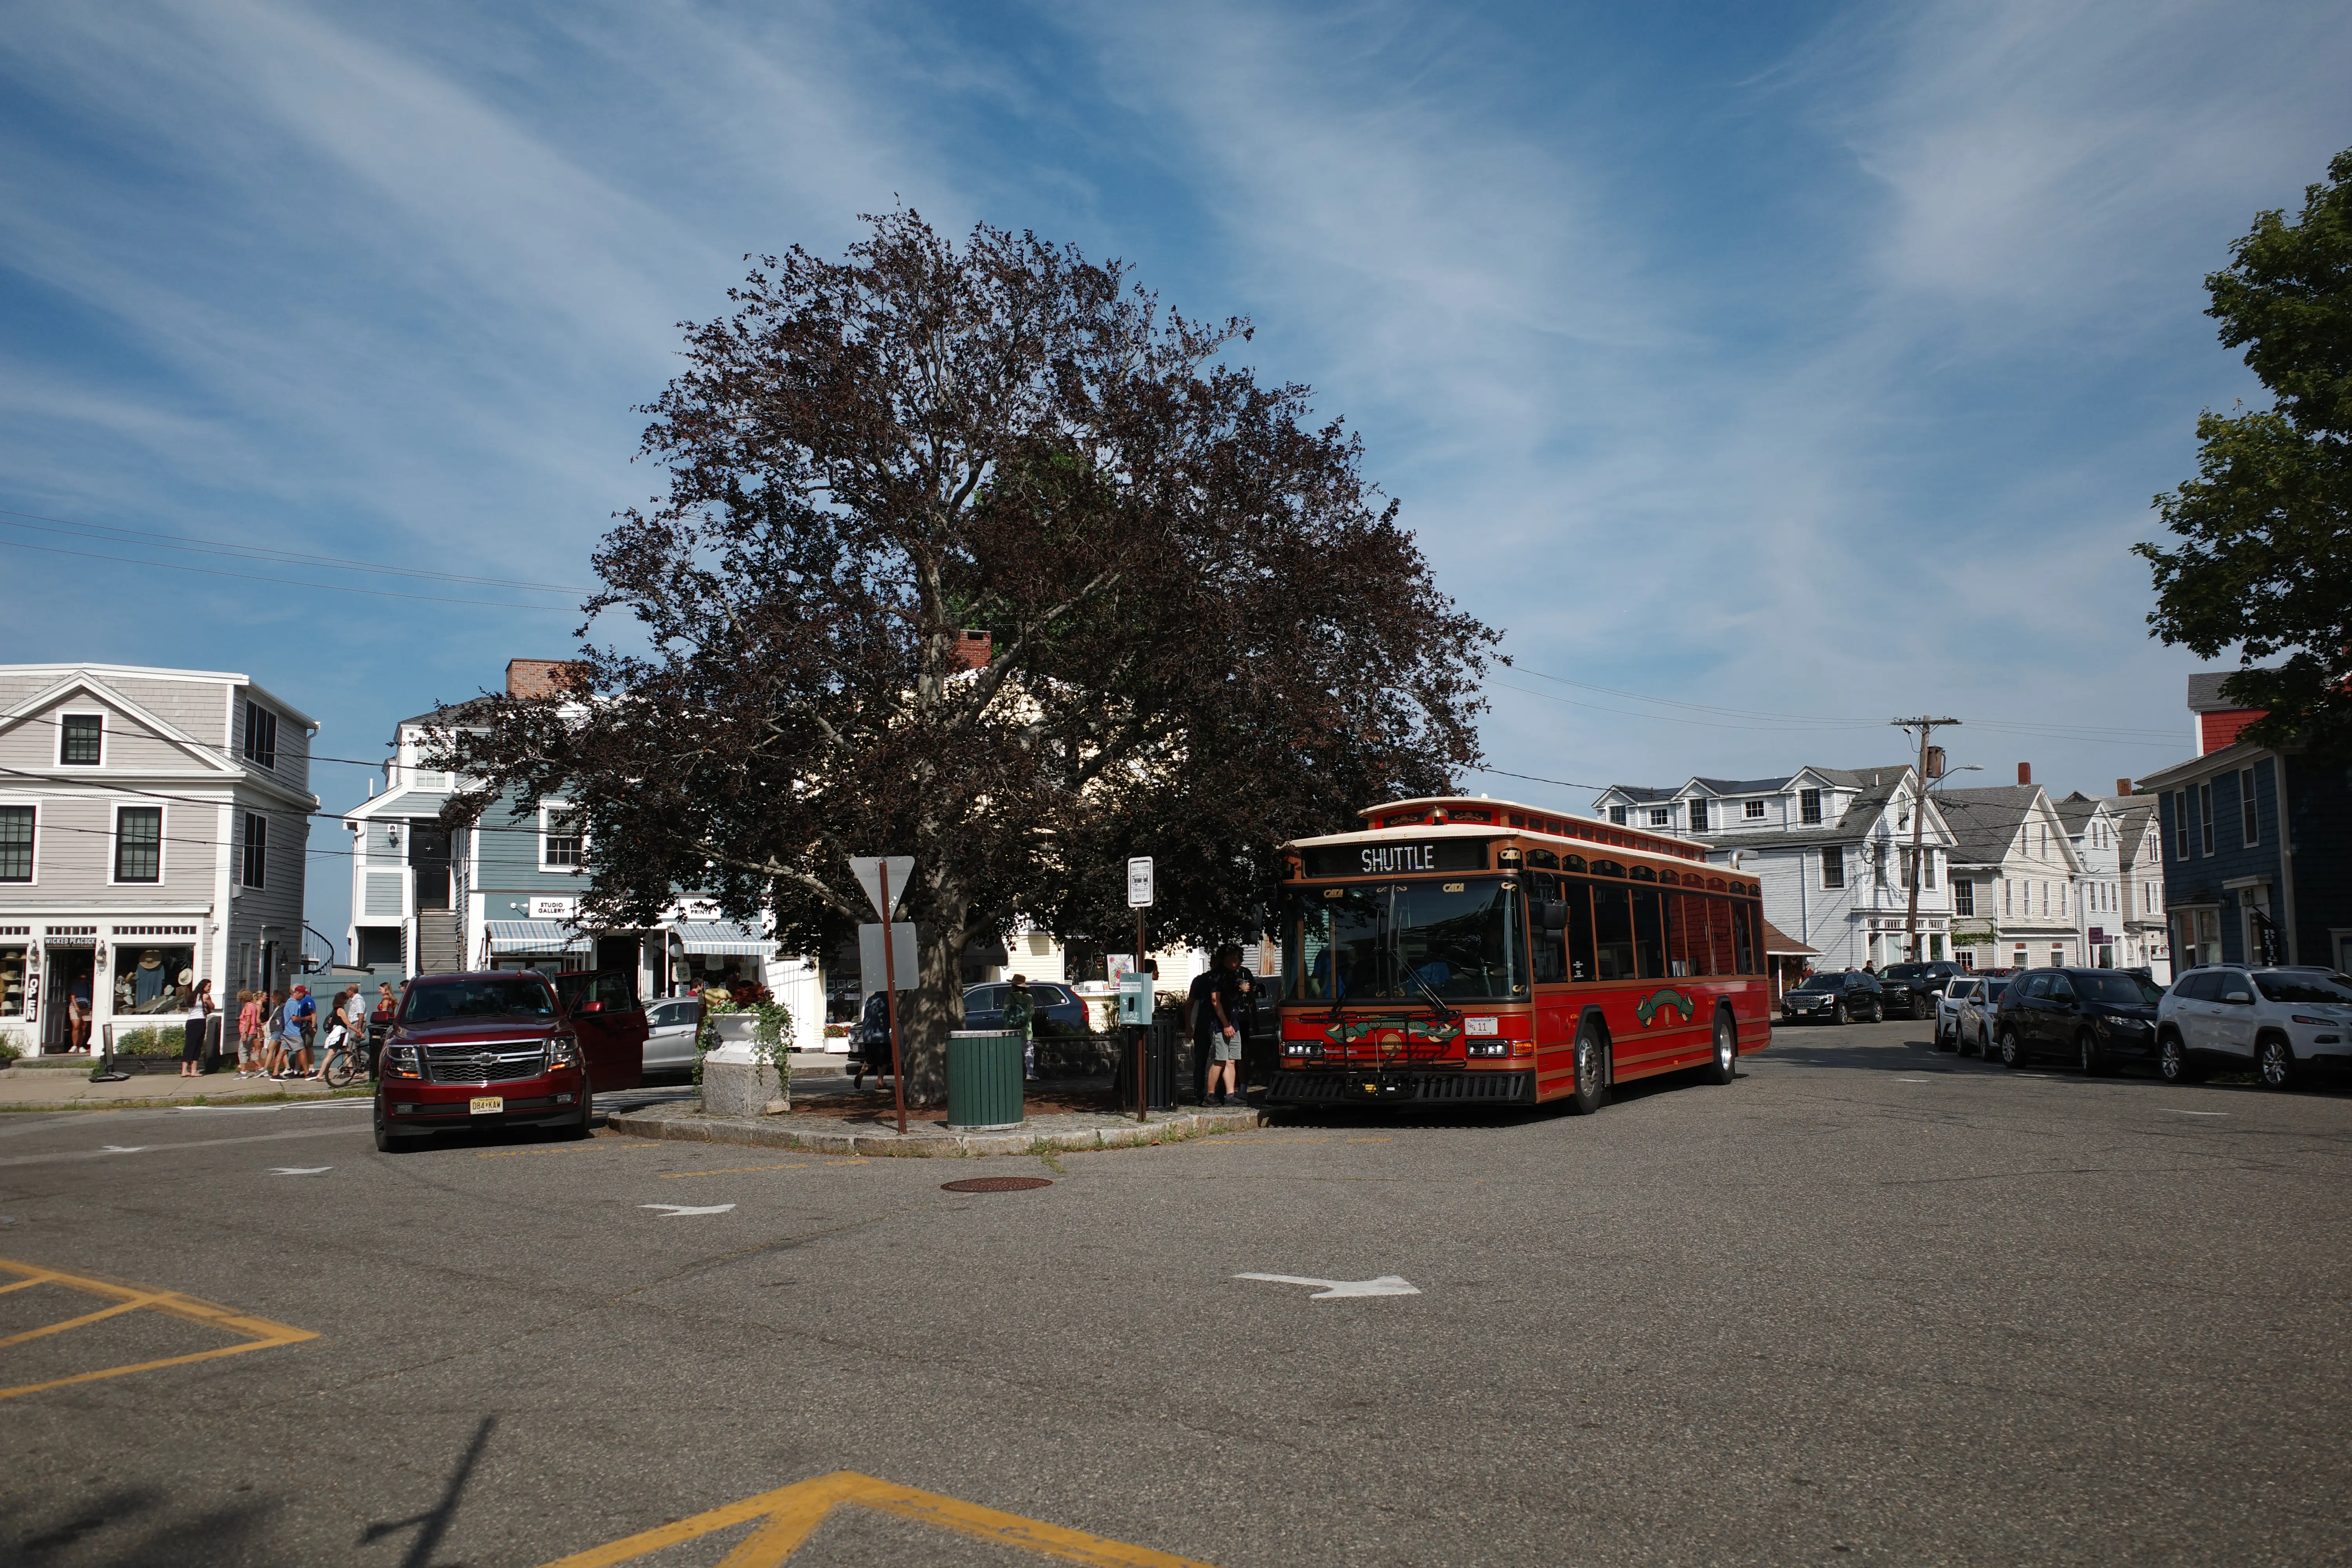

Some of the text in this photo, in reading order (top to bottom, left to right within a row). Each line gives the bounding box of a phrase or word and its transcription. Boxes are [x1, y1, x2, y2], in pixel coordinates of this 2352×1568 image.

[1361, 846, 1434, 872] SHUTTLE
[1500, 849, 1521, 860] CATA
[1443, 883, 1464, 892] CATA
[1323, 889, 1343, 898] CATA
[26, 978, 38, 1020] OPEN
